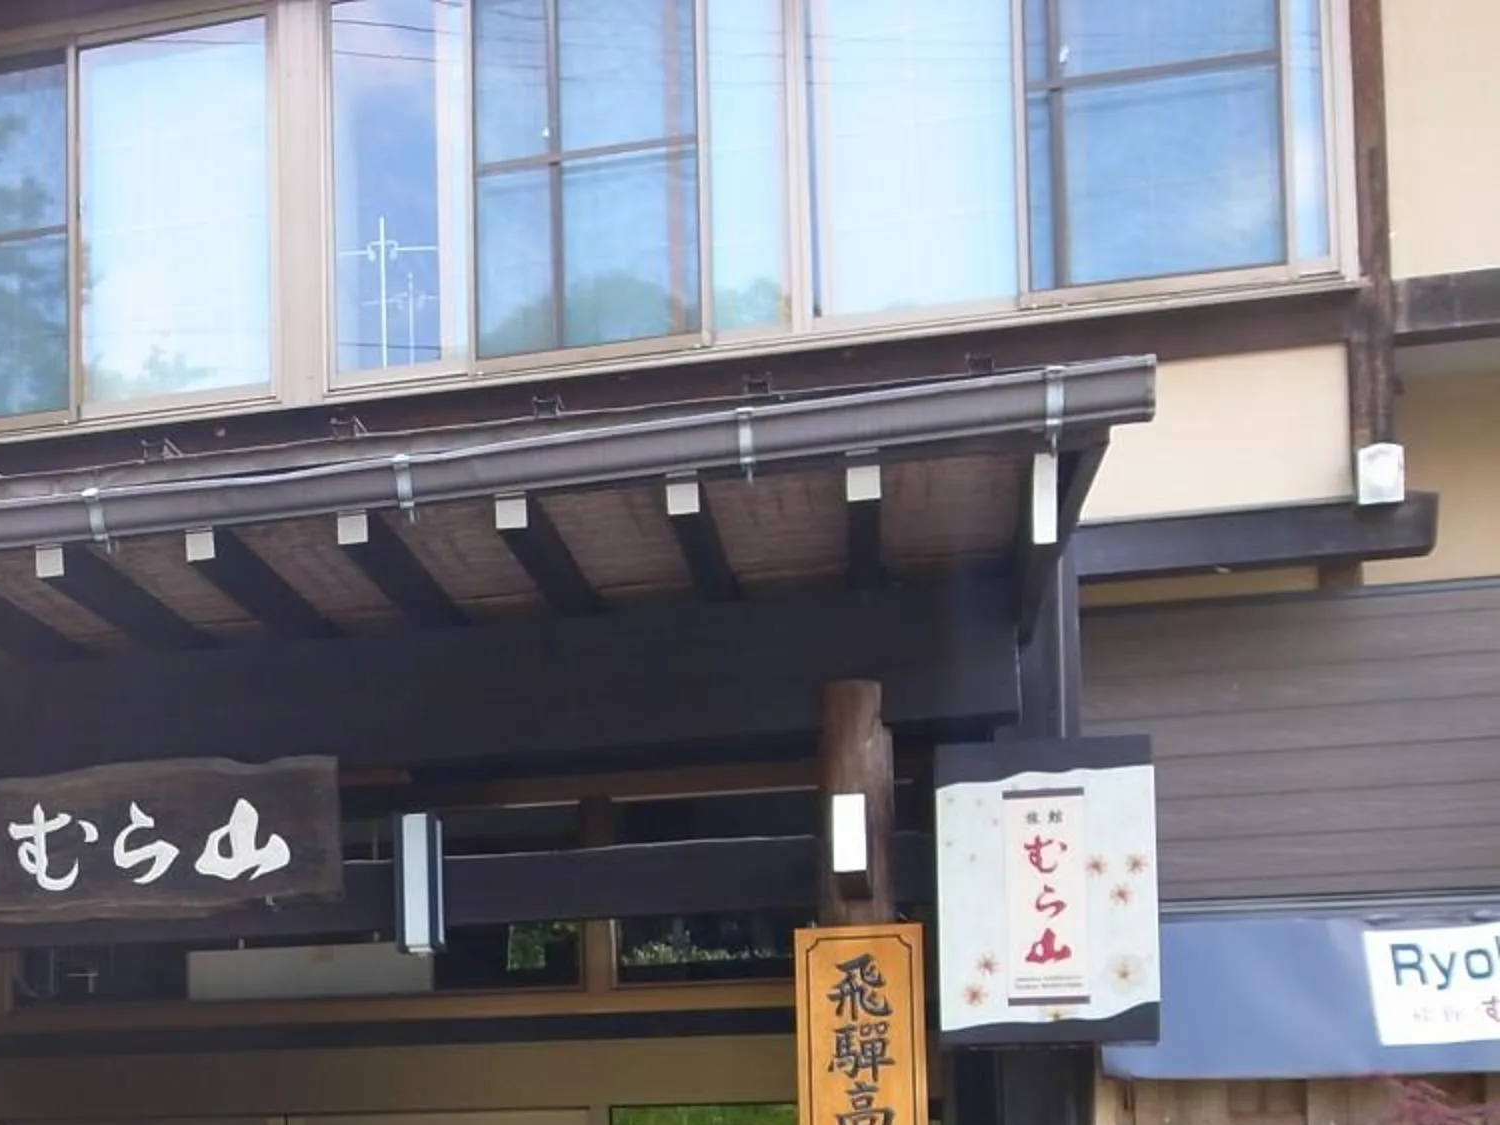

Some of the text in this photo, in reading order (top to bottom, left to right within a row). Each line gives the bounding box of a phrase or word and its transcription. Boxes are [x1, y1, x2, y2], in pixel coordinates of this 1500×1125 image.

[8, 798, 291, 892] むら山
[1024, 835, 1072, 964] むら山
[1389, 935, 1500, 990] Ryo
